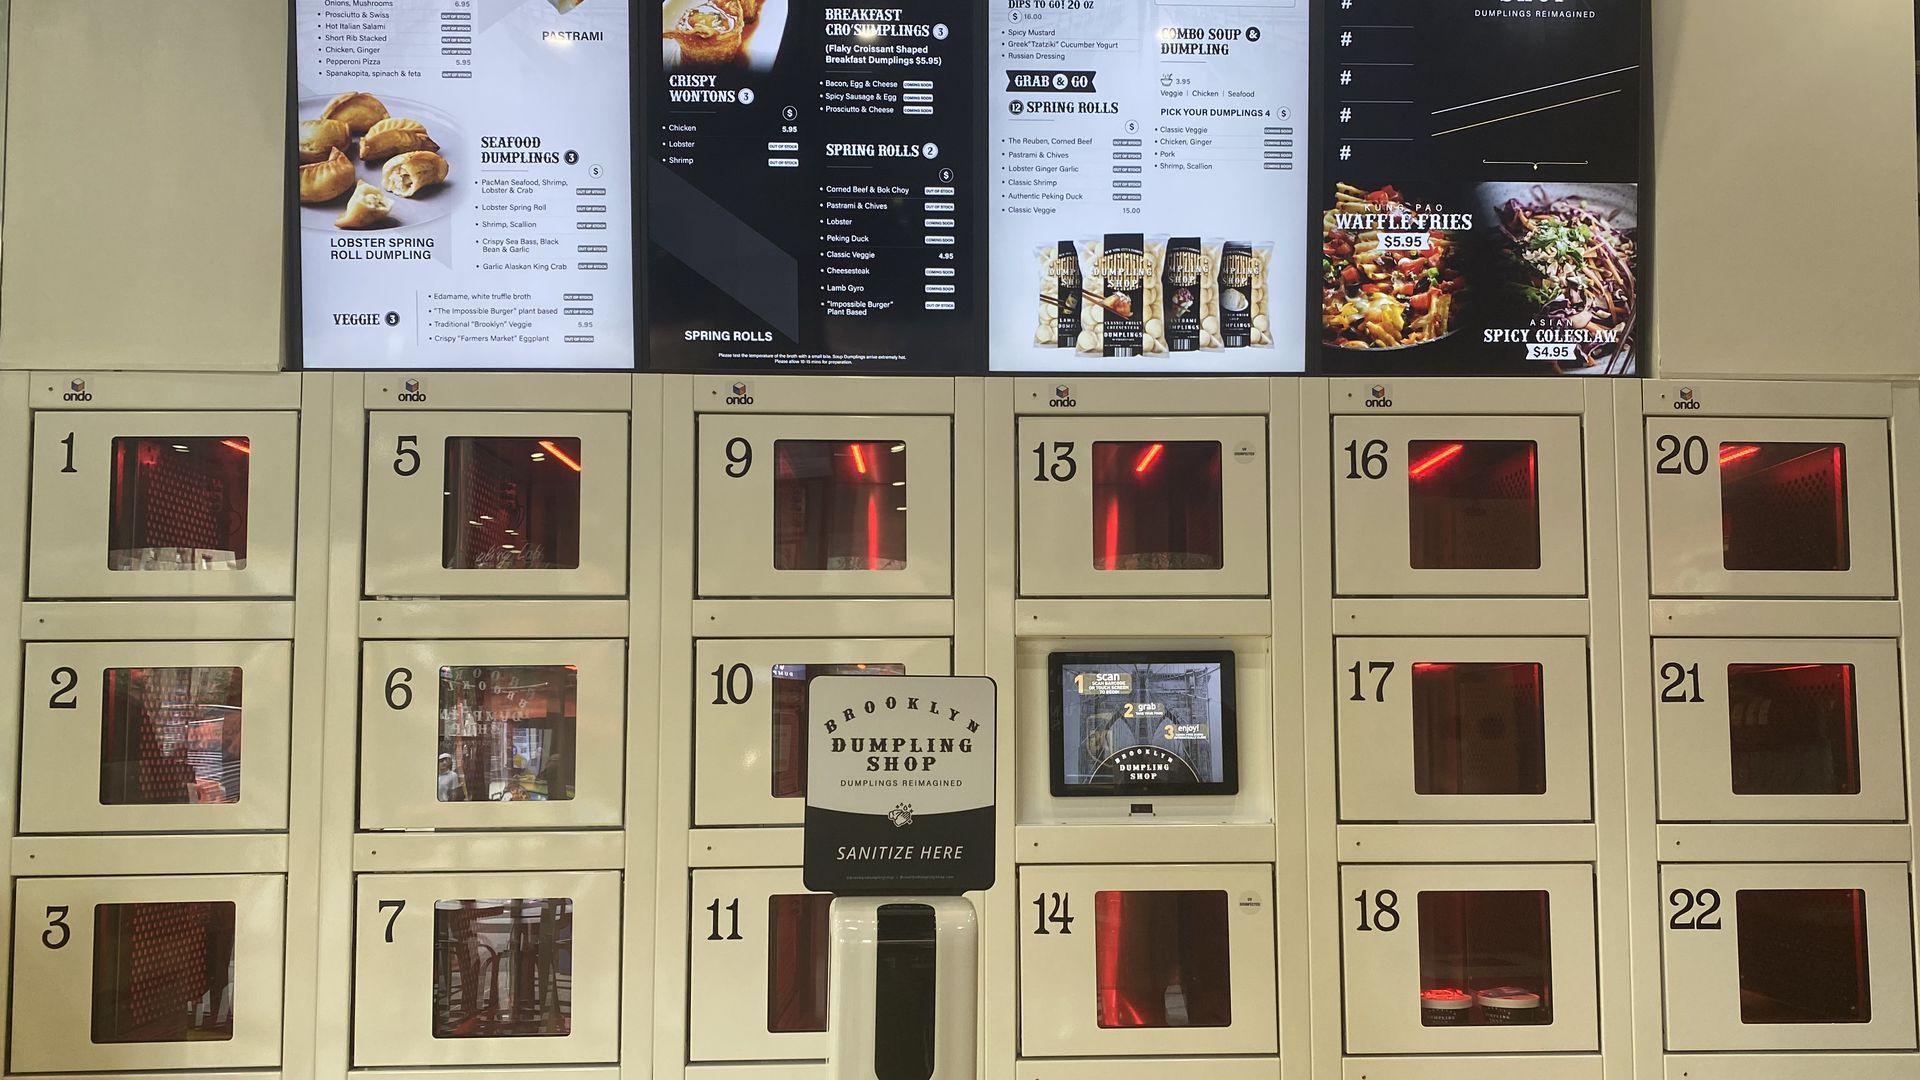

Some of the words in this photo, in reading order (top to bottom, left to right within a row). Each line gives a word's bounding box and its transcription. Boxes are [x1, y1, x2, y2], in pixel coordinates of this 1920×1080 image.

[1008, 0, 1031, 9] DIPS
[1033, 0, 1046, 9] TO
[1048, 0, 1065, 9] GO!
[1067, 0, 1081, 10] 20
[1083, 0, 1094, 9] OZ
[325, 10, 361, 19] Prosciutto
[361, 11, 368, 19] &
[369, 11, 390, 19] Swiss
[825, 8, 903, 22] BREAKFAST
[1474, 9, 1531, 18] DUMPLINGS
[1535, 10, 1595, 18] REIMAGINED
[541, 31, 604, 42] PASTRAMI
[1208, 28, 1242, 41] SOUP
[1249, 29, 1258, 39] &
[825, 44, 853, 57] (Flaky
[853, 44, 894, 53] Croissant
[896, 45, 928, 55] Shaped
[1161, 43, 1229, 56] DUMPLING
[825, 55, 867, 64] Breakfast
[868, 53, 914, 66] Dumplings
[915, 56, 942, 66] $5.95)
[669, 74, 717, 87] CRISPY
[825, 79, 849, 88] Bacon,
[850, 80, 864, 89] Egg
[872, 80, 898, 88] Cheese
[1014, 74, 1050, 87] GRAB
[1056, 77, 1065, 87] &
[1071, 75, 1088, 88] GO
[669, 89, 736, 103] WONTONS
[825, 92, 845, 101] Spicy
[845, 92, 875, 102] Sausage
[875, 93, 882, 101] &
[883, 93, 897, 102] Egg
[1160, 90, 1183, 98] Veggie
[1191, 89, 1219, 97] Chicken
[1227, 90, 1255, 98] Seafood
[825, 105, 860, 113] Prosciutto
[861, 105, 867, 113] &
[868, 106, 894, 114] Cheese
[1011, 103, 1021, 113] 12
[1026, 101, 1075, 114] SPRING
[1078, 101, 1119, 114] ROLLS
[1160, 108, 1182, 116] PICK
[1183, 108, 1208, 116] YOUR
[1210, 108, 1263, 117] DUMPLINGS
[668, 124, 697, 132] Chicken
[481, 136, 541, 149] SEAFOOD
[669, 140, 695, 148] Lobster
[826, 143, 875, 157] SPRING
[878, 144, 920, 158] ROLLS
[1160, 150, 1176, 158] Pork
[481, 151, 560, 164] DUMPLINGS
[568, 154, 575, 162] 3
[669, 156, 694, 165] Shrimp
[1007, 178, 1032, 186] Classic
[1033, 178, 1058, 188] Shrimp
[826, 185, 851, 193] Corned
[852, 185, 869, 193] Beef
[877, 186, 891, 194] Bok
[891, 186, 910, 195] Choy
[1008, 192, 1040, 200] Authentic
[1041, 192, 1064, 201] Peking
[1065, 192, 1083, 200] Duck
[509, 203, 532, 212] Spring
[826, 201, 856, 209] Pastrami
[864, 202, 888, 210] Chives
[1363, 203, 1405, 211] KUNG
[1415, 203, 1444, 211] PAO
[1336, 214, 1410, 231] WAFFLE
[1418, 214, 1473, 231] FRIES
[330, 238, 386, 248] LOBSTER
[389, 238, 434, 248] SPRING
[826, 234, 850, 244] Peking
[851, 234, 869, 242] Duck
[1384, 235, 1422, 248] $5.95
[331, 250, 363, 260] ROLL
[366, 250, 431, 260] DUMPLING
[826, 250, 851, 258] Classic
[851, 251, 875, 260] Veggie
[938, 252, 954, 260] 4.95
[826, 266, 870, 275] Cheesesteak
[1093, 267, 1153, 277] DUMPLING
[827, 284, 847, 292] Lamb
[847, 284, 865, 293] Gyro
[1107, 279, 1138, 288] SHOP
[333, 313, 380, 326] VEGGIE
[389, 314, 396, 323] 3
[1529, 319, 1575, 327] ASIAN
[684, 330, 730, 341] SPRING
[733, 331, 773, 342] ROLLS
[1483, 329, 1529, 344] SPICY
[1535, 329, 1618, 344] COLESLAW
[1533, 345, 1569, 358] $4.95
[63, 391, 92, 402] ondo
[397, 392, 426, 402] ondo
[726, 394, 754, 405] ondo
[1049, 397, 1076, 407] ondo
[1365, 397, 1393, 408] ondo
[1673, 399, 1700, 410] ondo
[60, 432, 78, 473] 1
[393, 435, 421, 477] 5
[725, 437, 753, 478] 9
[1656, 434, 1709, 475] 20
[1032, 441, 1077, 482] 13
[1344, 439, 1388, 480] 16
[49, 666, 78, 709] 2
[711, 663, 753, 705] 10
[1074, 675, 1085, 694] 1
[1096, 674, 1120, 682] scan
[1348, 660, 1395, 702] 17
[1660, 662, 1705, 703] 21
[385, 667, 413, 710] 6
[824, 696, 981, 734] BROOKLYN
[1124, 704, 1134, 718] 2
[1138, 703, 1157, 712] grab
[1164, 725, 1175, 740] 3
[1177, 724, 1200, 734] enjoy!
[831, 737, 972, 753] DUMPLING
[1114, 749, 1174, 764] BROOKLYN
[866, 756, 936, 772] SHOP
[1119, 764, 1170, 772] DUMPLING
[1130, 772, 1157, 780] SHOP
[840, 779, 898, 787] DUMPLINGS
[902, 779, 963, 787] REIMAGINED
[836, 846, 914, 860] SANITIZE
[920, 846, 964, 859] HERE
[1033, 892, 1075, 935] 14
[1354, 889, 1400, 932] 18
[1669, 888, 1722, 930] 22
[378, 899, 406, 943] 7
[706, 897, 743, 941] 11
[42, 905, 71, 950] 3
